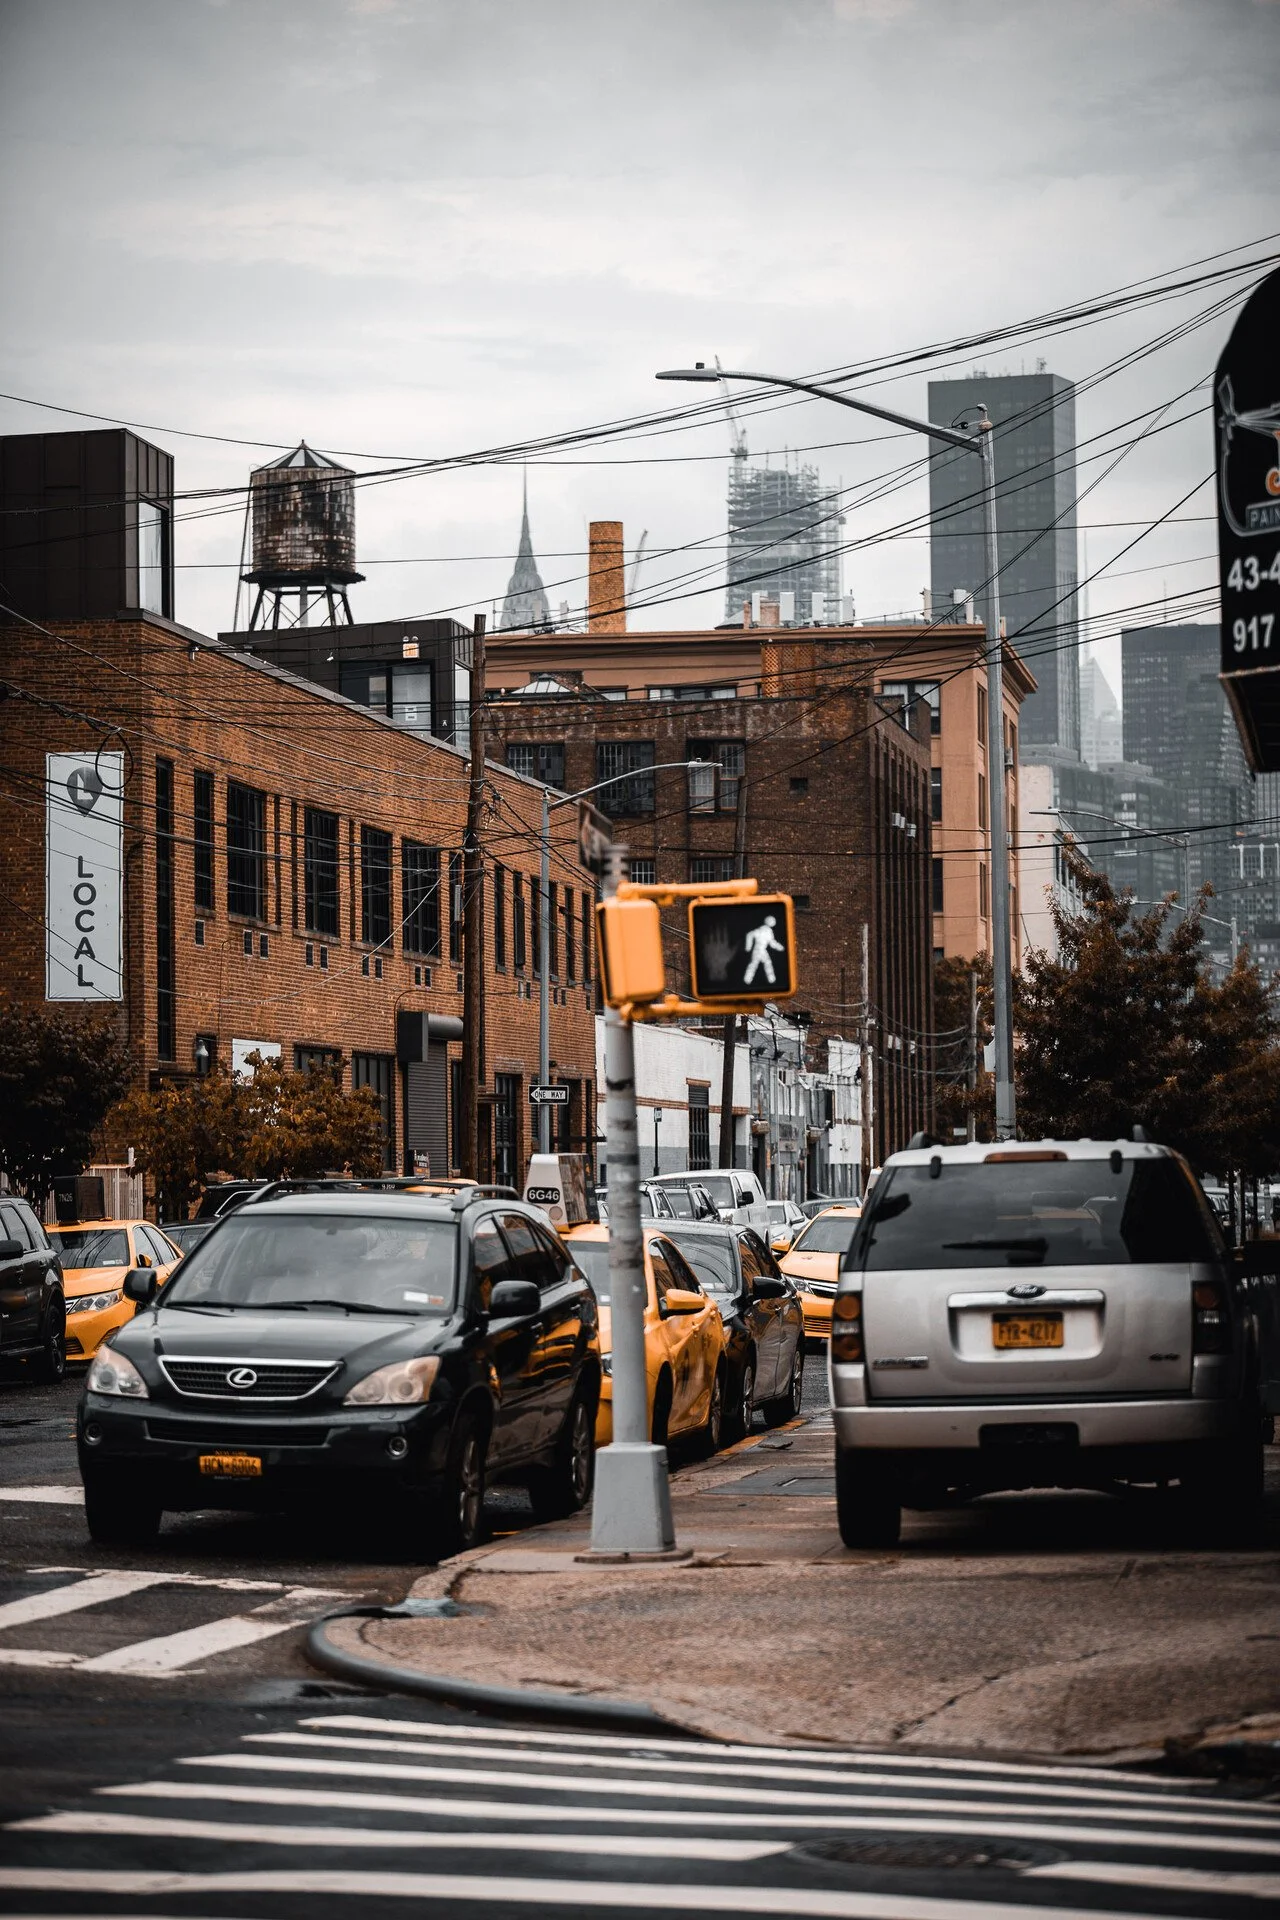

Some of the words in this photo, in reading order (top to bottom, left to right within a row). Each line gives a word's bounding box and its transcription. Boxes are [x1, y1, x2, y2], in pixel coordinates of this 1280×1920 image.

[1233, 613, 1275, 652] 917
[73, 855, 97, 987] LOCAL
[534, 1091, 546, 1099] ONE
[550, 1091, 564, 1099] WAY
[528, 1189, 559, 1201] 6G46
